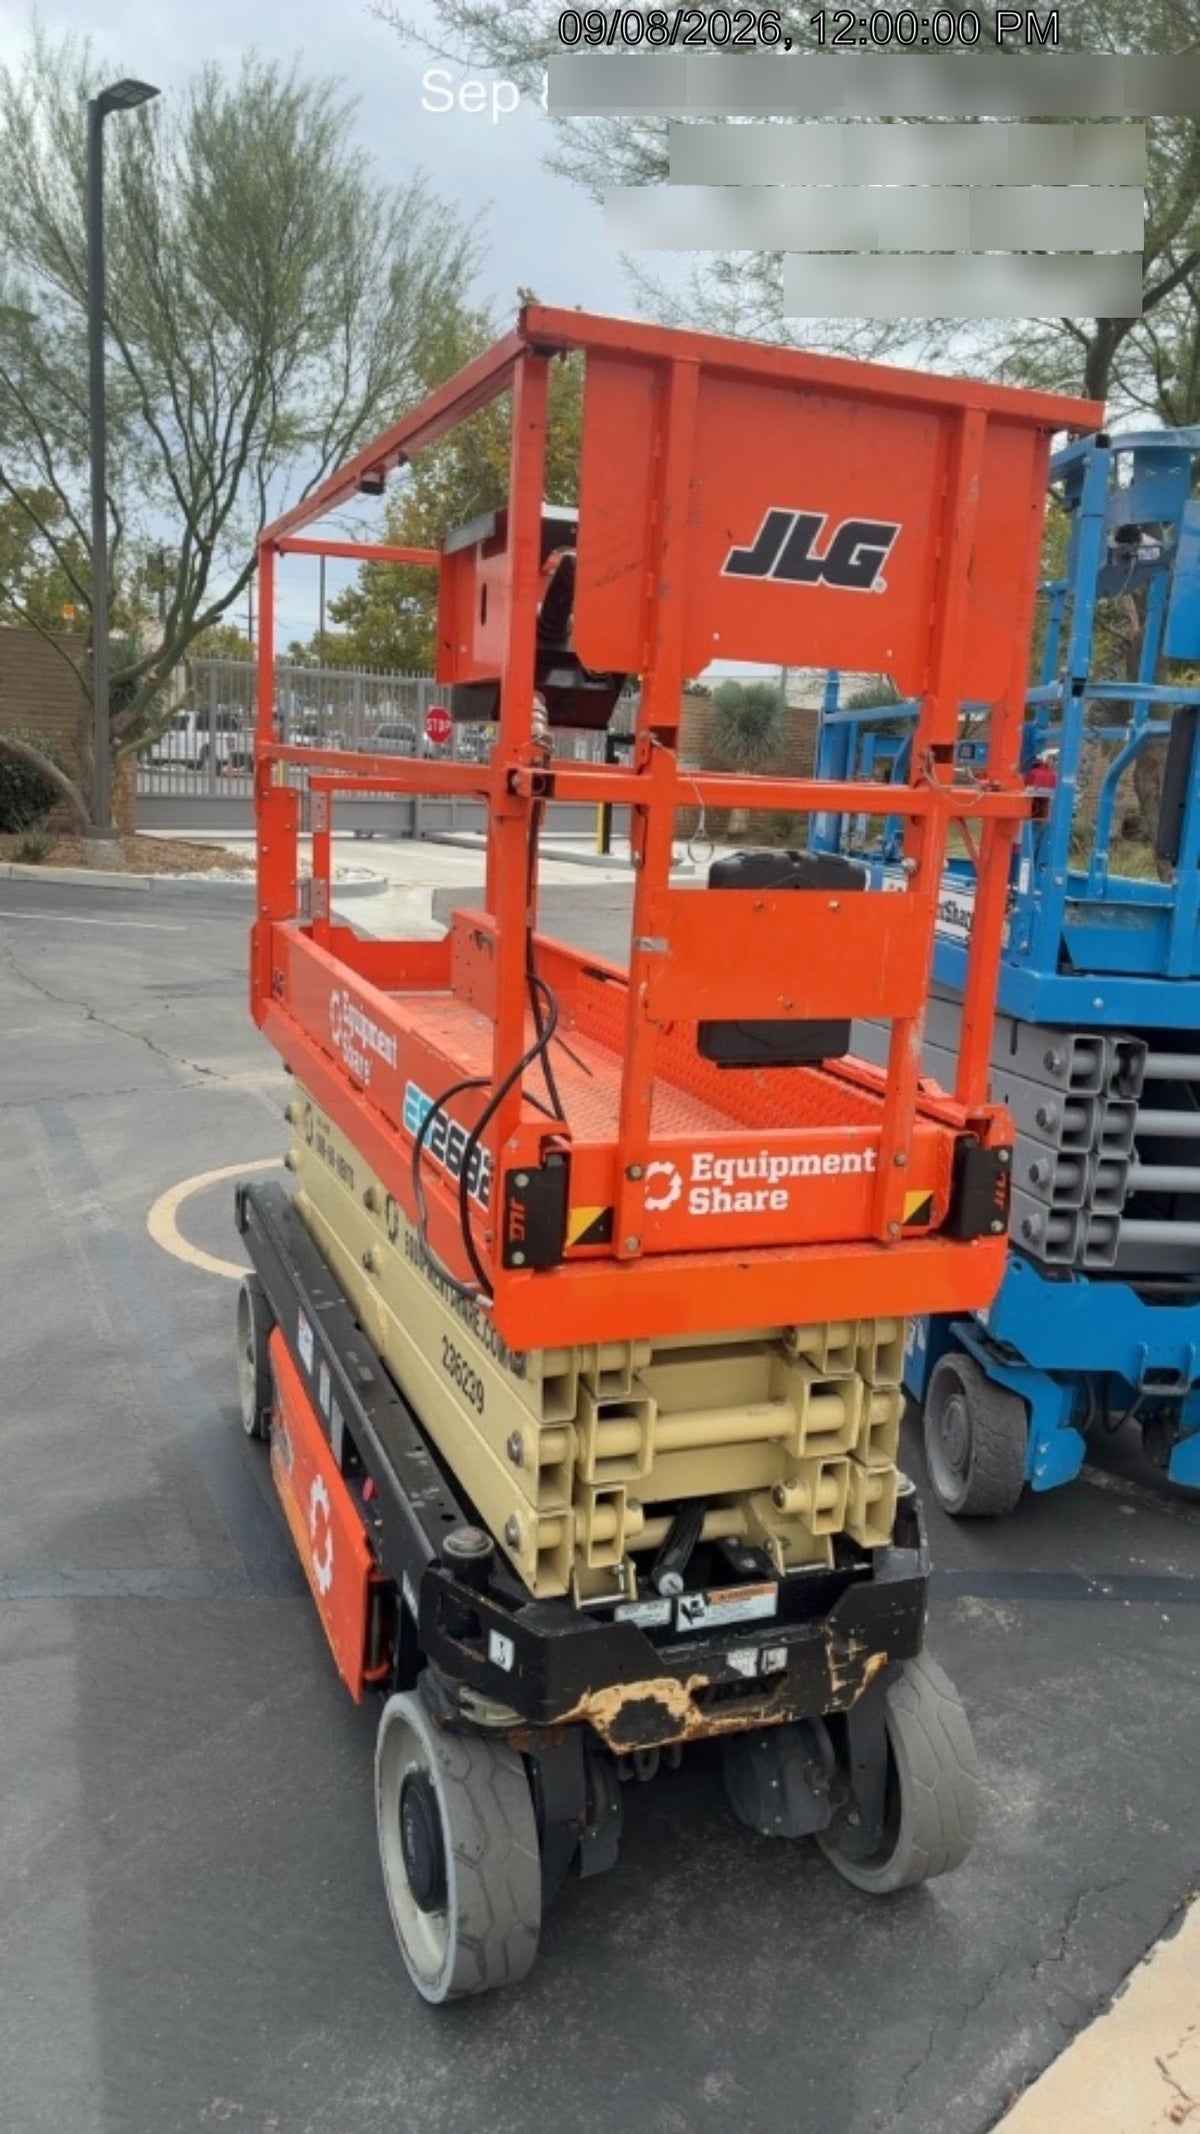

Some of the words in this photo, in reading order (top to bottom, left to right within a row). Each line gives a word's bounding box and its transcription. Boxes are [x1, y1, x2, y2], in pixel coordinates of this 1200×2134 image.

[720, 506, 902, 593] JLG
[426, 717, 452, 733] STOP
[690, 1147, 877, 1186] Equipment
[510, 1196, 526, 1243] JLG
[688, 1186, 789, 1215] Share
